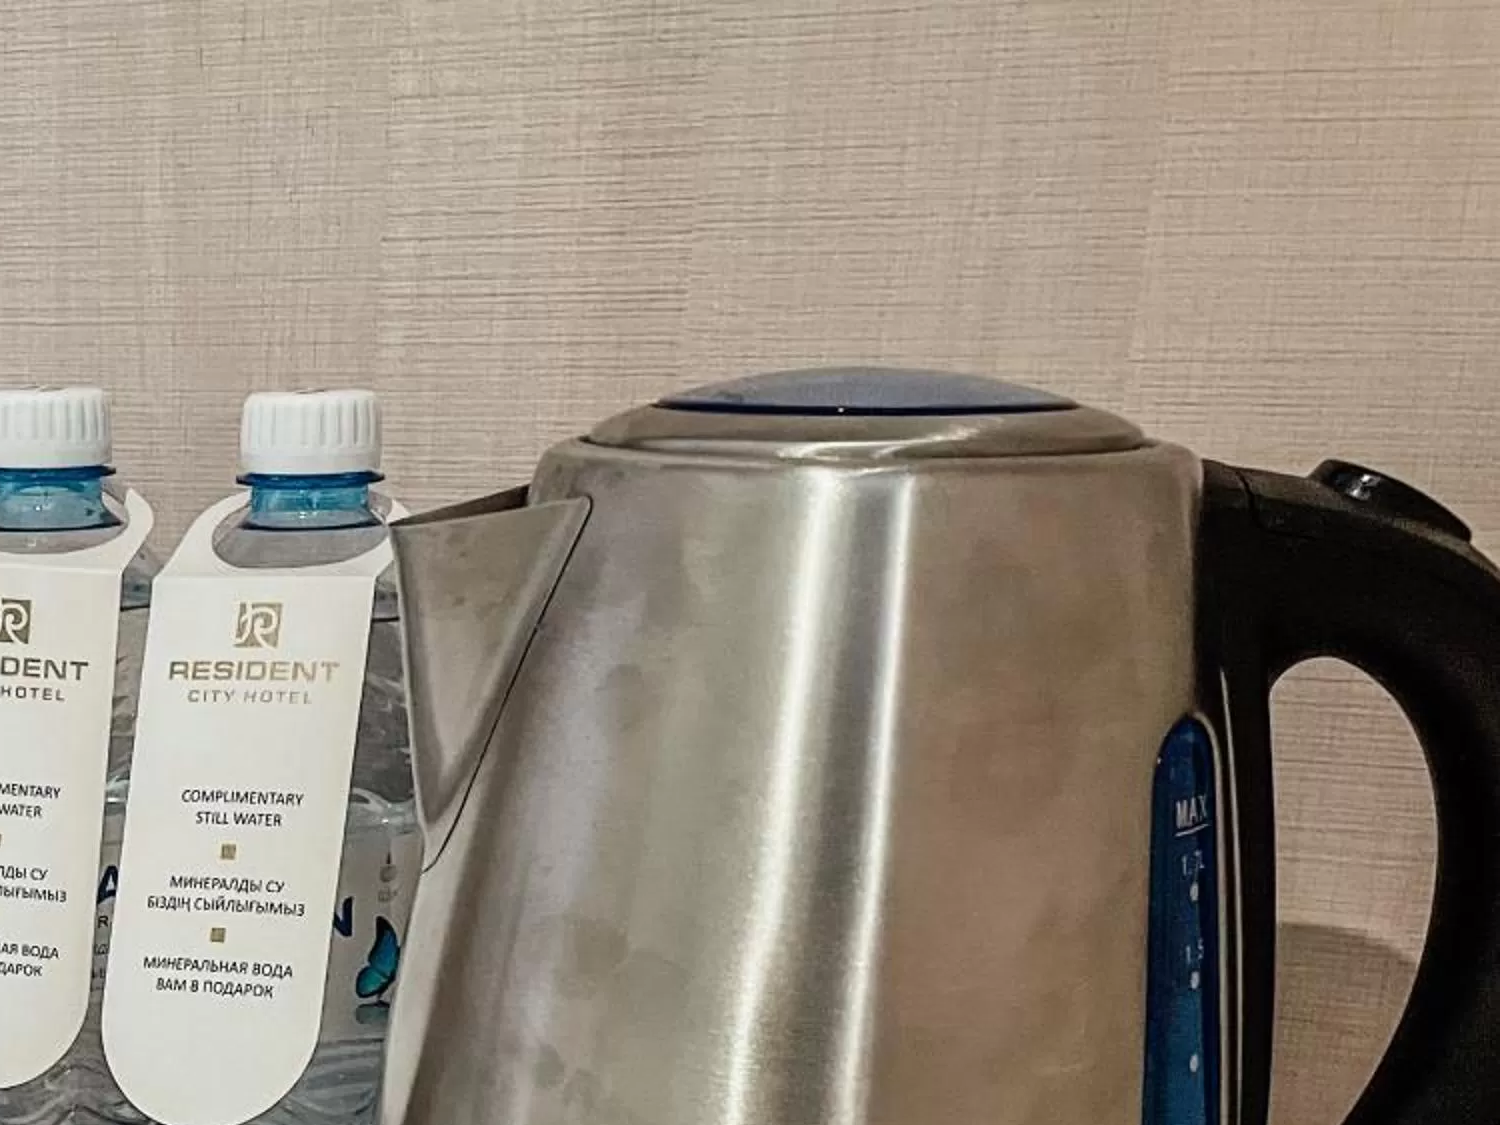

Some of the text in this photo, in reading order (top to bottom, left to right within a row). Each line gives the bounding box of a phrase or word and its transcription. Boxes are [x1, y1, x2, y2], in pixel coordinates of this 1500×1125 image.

[168, 660, 340, 682] RESIDENT
[0, 685, 65, 702] HOTEL
[187, 688, 312, 705] CITY HOTEL
[181, 788, 305, 807] COMPLIMENTARY
[195, 811, 283, 828] STILL WATER
[30, 867, 49, 881] СУ
[169, 875, 286, 894] МИНЕРАЛДЫ СУ
[21, 945, 60, 959] ВОДА
[143, 956, 293, 980] МИНЕРАЛЬНАЯ ВОДА
[156, 978, 274, 999] ВАМ В ПОДАРОК
